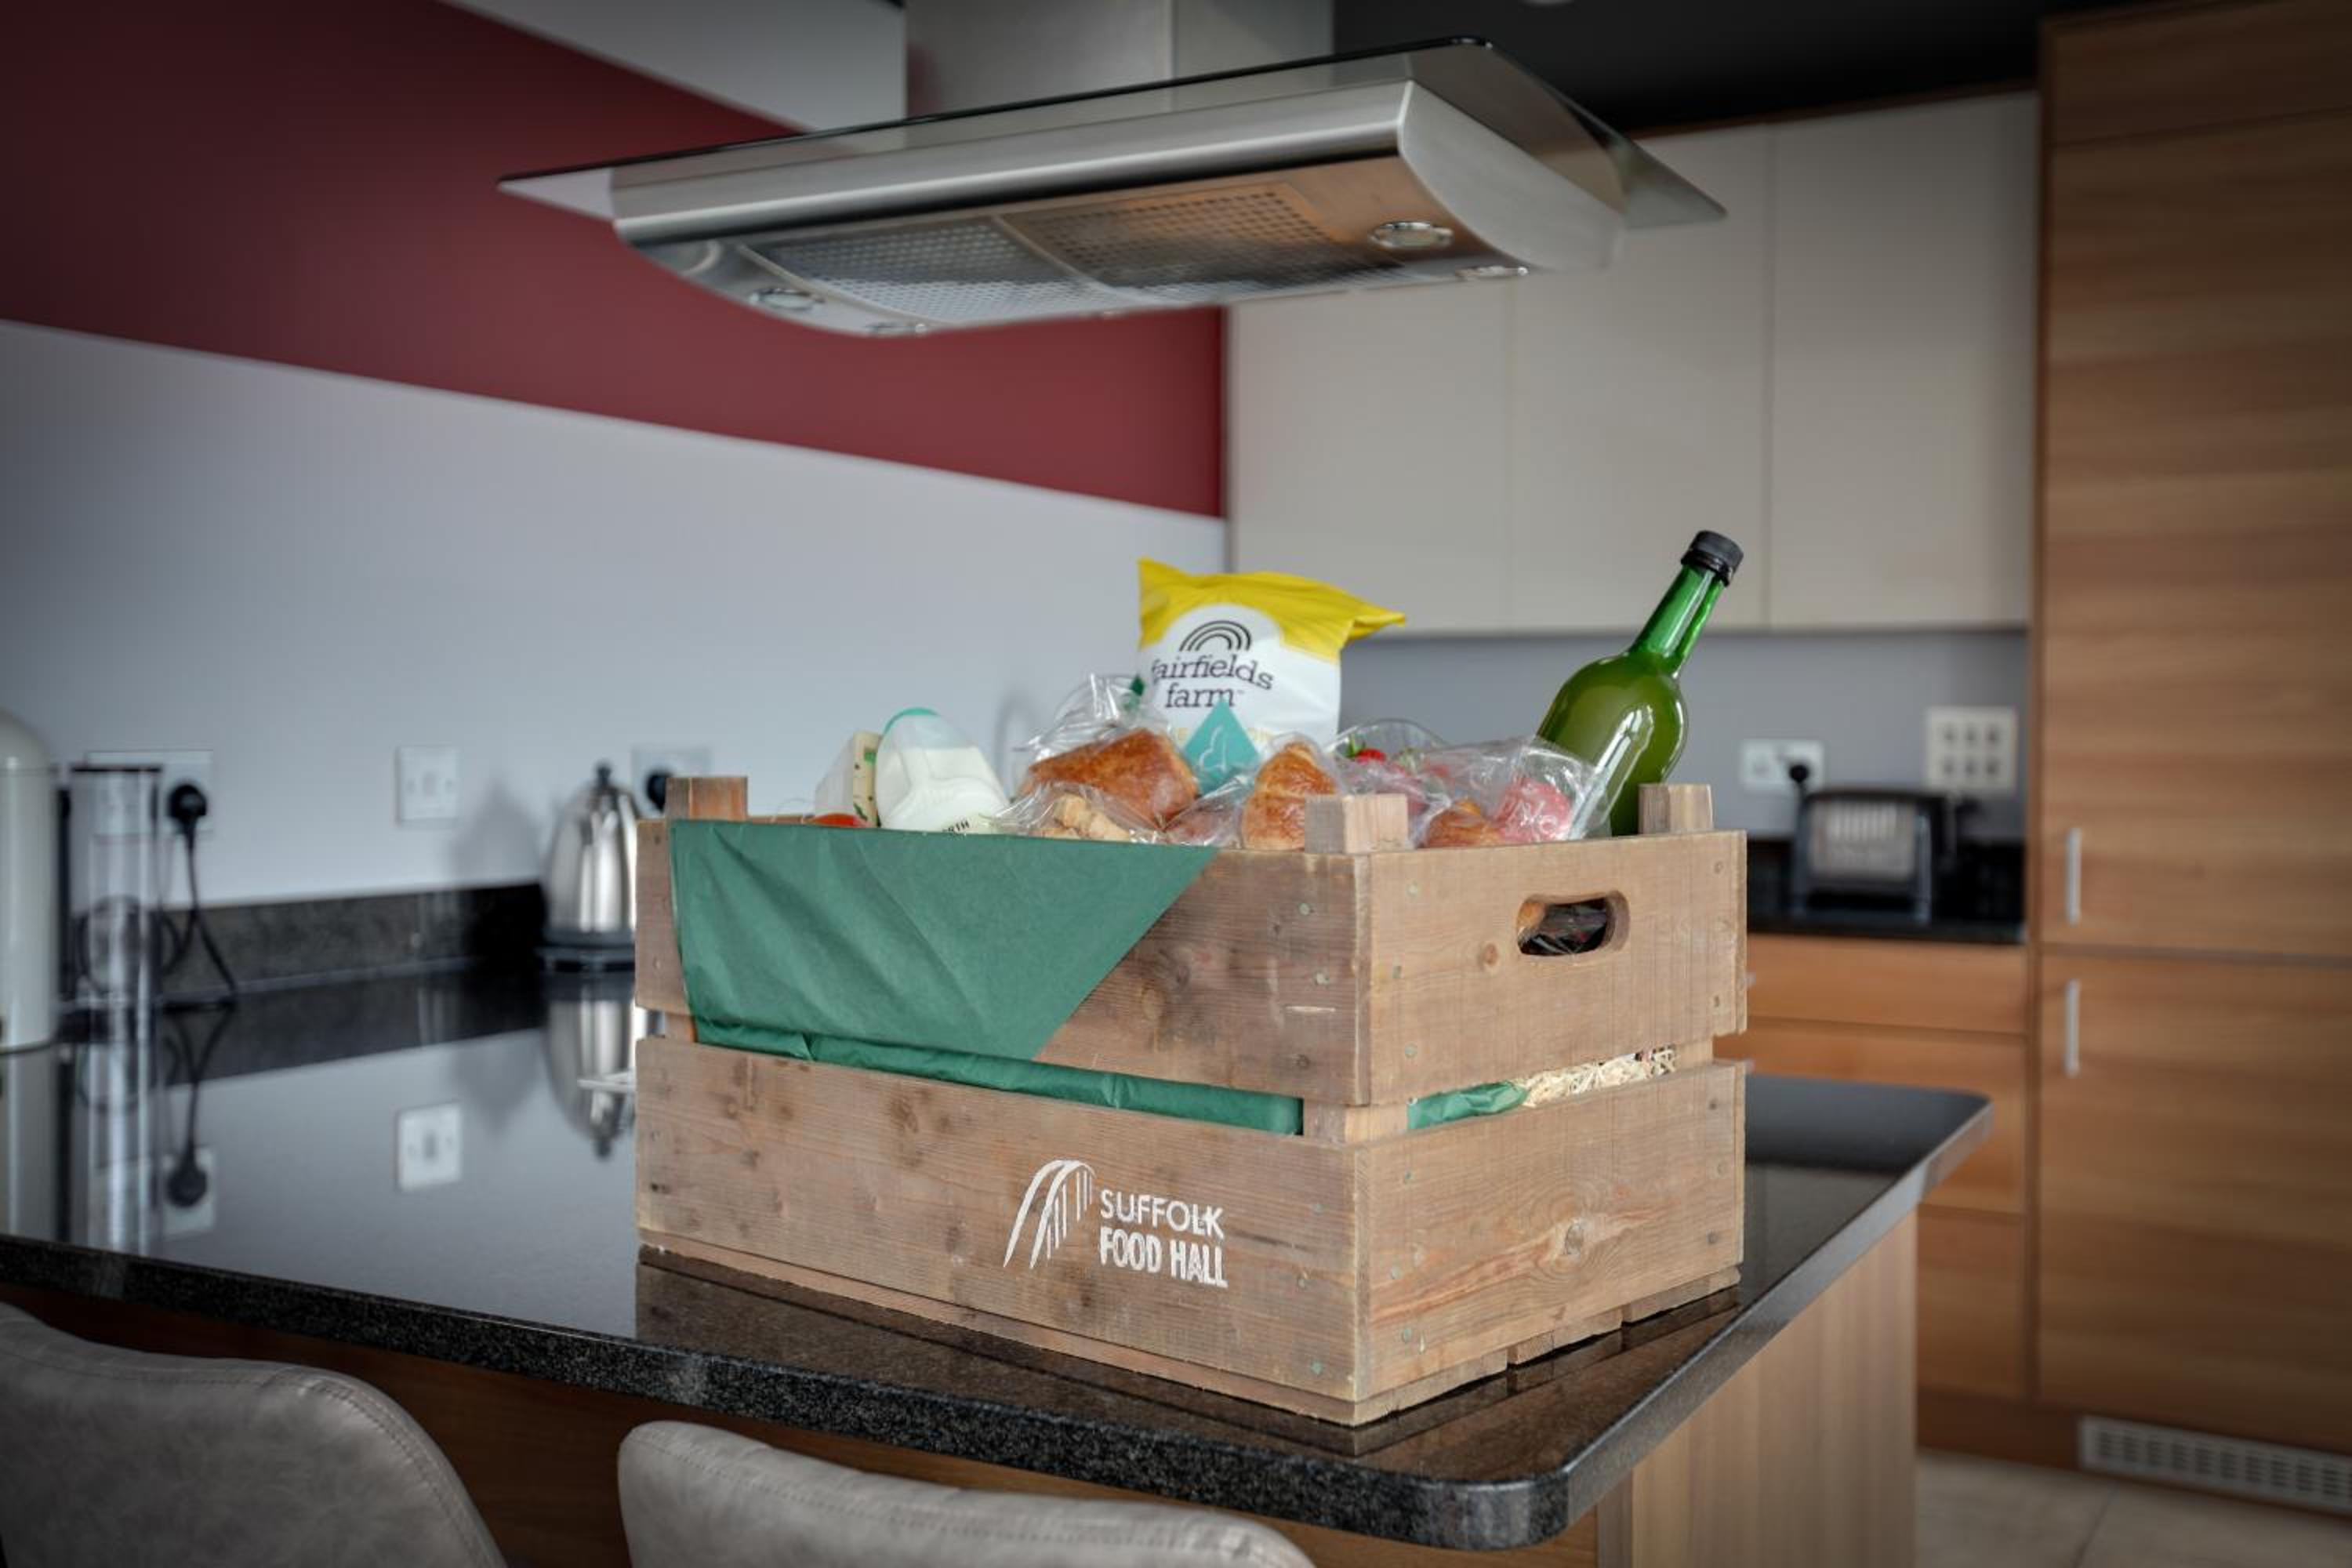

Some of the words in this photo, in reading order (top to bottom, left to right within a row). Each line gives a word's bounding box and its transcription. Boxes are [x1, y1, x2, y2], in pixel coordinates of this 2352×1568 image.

[1165, 682, 1236, 708] farm
[1100, 1189, 1225, 1240] SUFFOLK
[1100, 1226, 1163, 1272] FOOD
[1170, 1240, 1229, 1288] HALL
